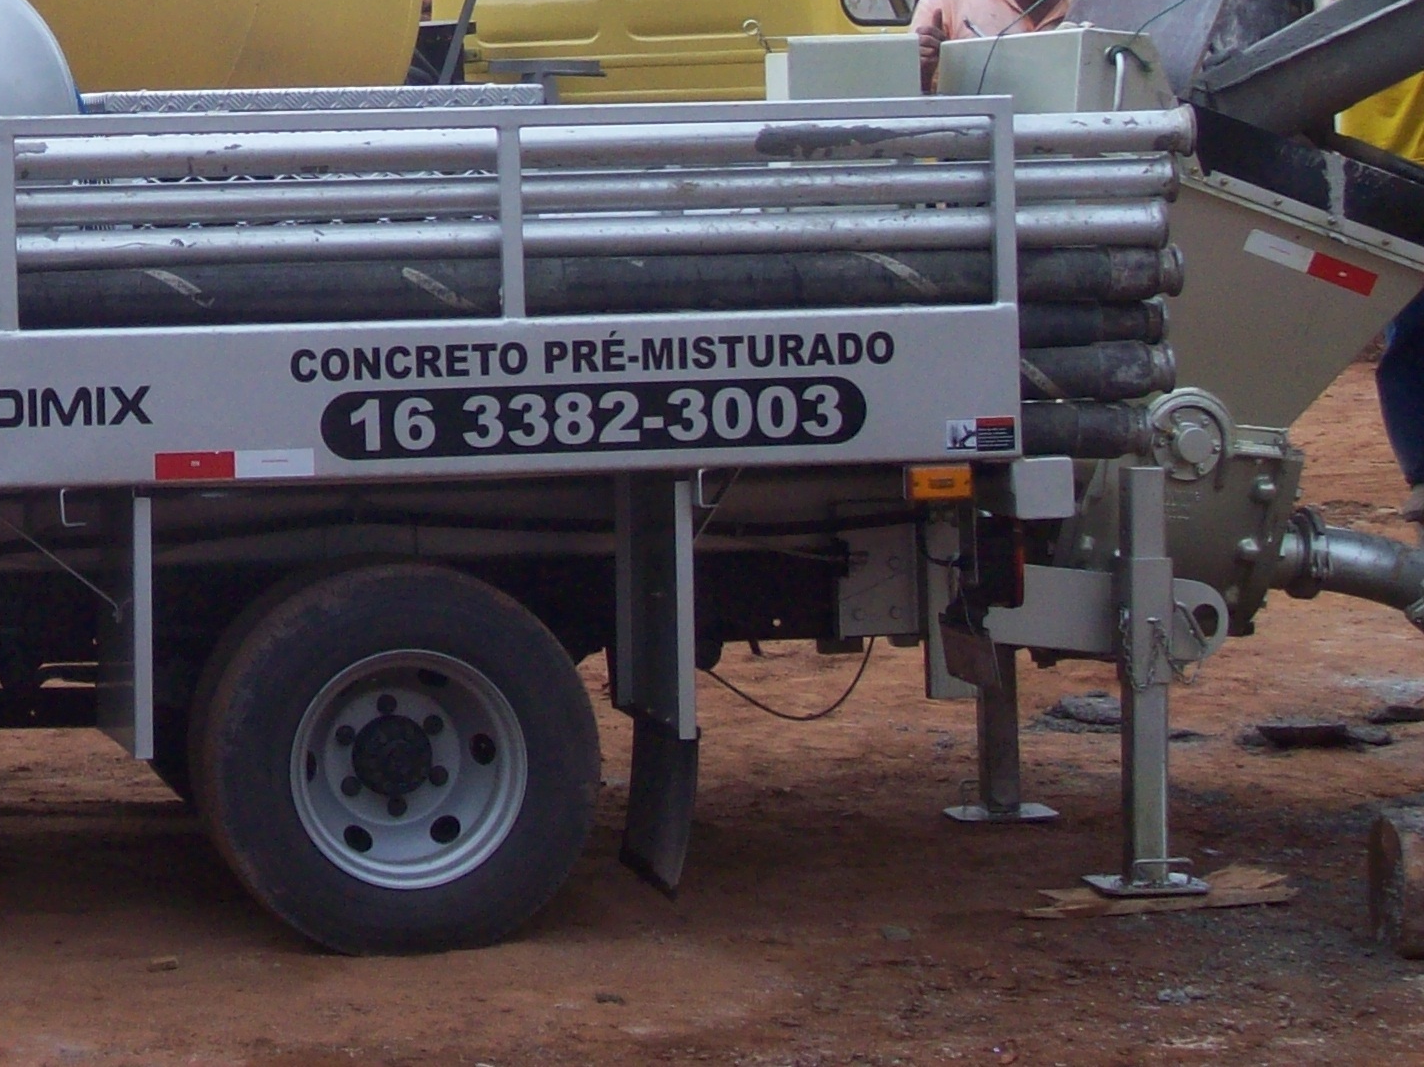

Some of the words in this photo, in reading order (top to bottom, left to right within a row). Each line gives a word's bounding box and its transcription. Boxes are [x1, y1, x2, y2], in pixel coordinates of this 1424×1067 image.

[290, 340, 528, 383] CONCRETO
[543, 330, 895, 374] PRÉ-MISTURADO
[351, 397, 436, 451] 16
[462, 385, 843, 448] 3382-3003
